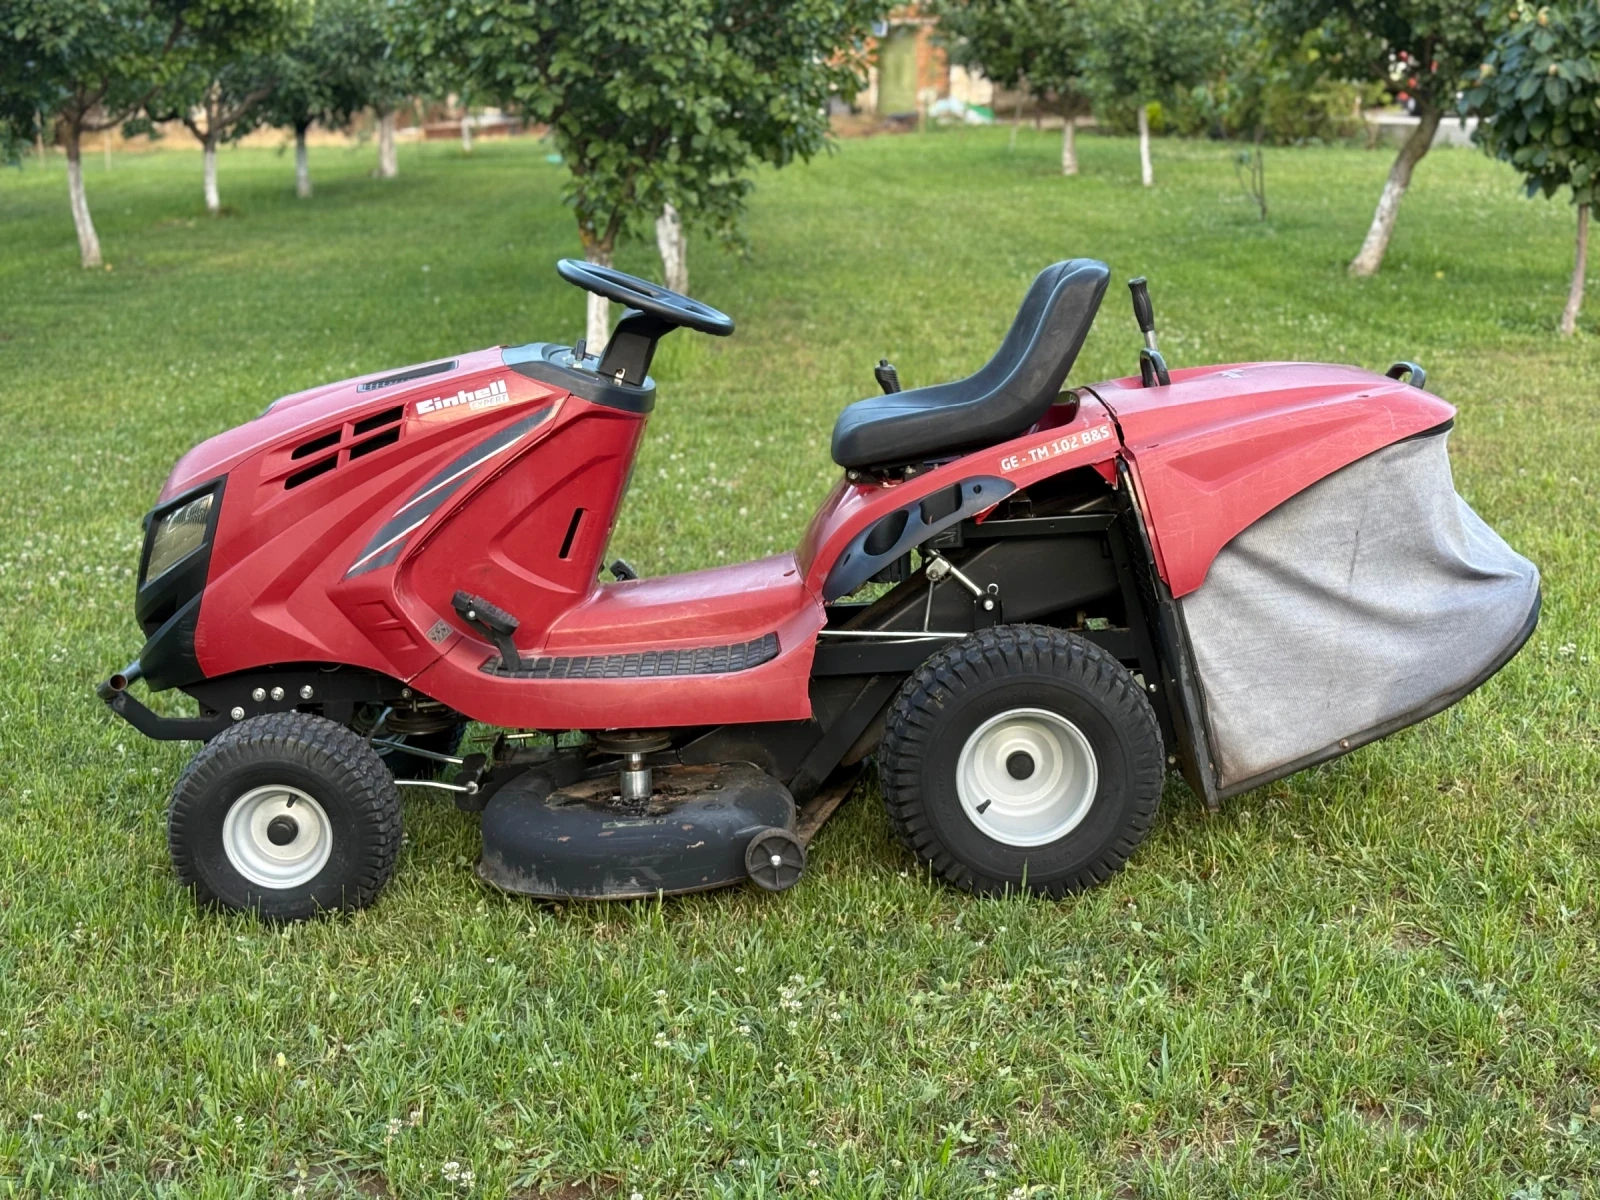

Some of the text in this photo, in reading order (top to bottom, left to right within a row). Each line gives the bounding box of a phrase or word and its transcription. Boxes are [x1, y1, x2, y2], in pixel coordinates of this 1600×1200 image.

[416, 380, 507, 414] Einhell
[471, 395, 507, 409] EXPERT
[1001, 456, 1019, 471] GE
[1028, 446, 1049, 462] TM
[1052, 436, 1079, 454] 102
[1081, 426, 1110, 445] B&S
